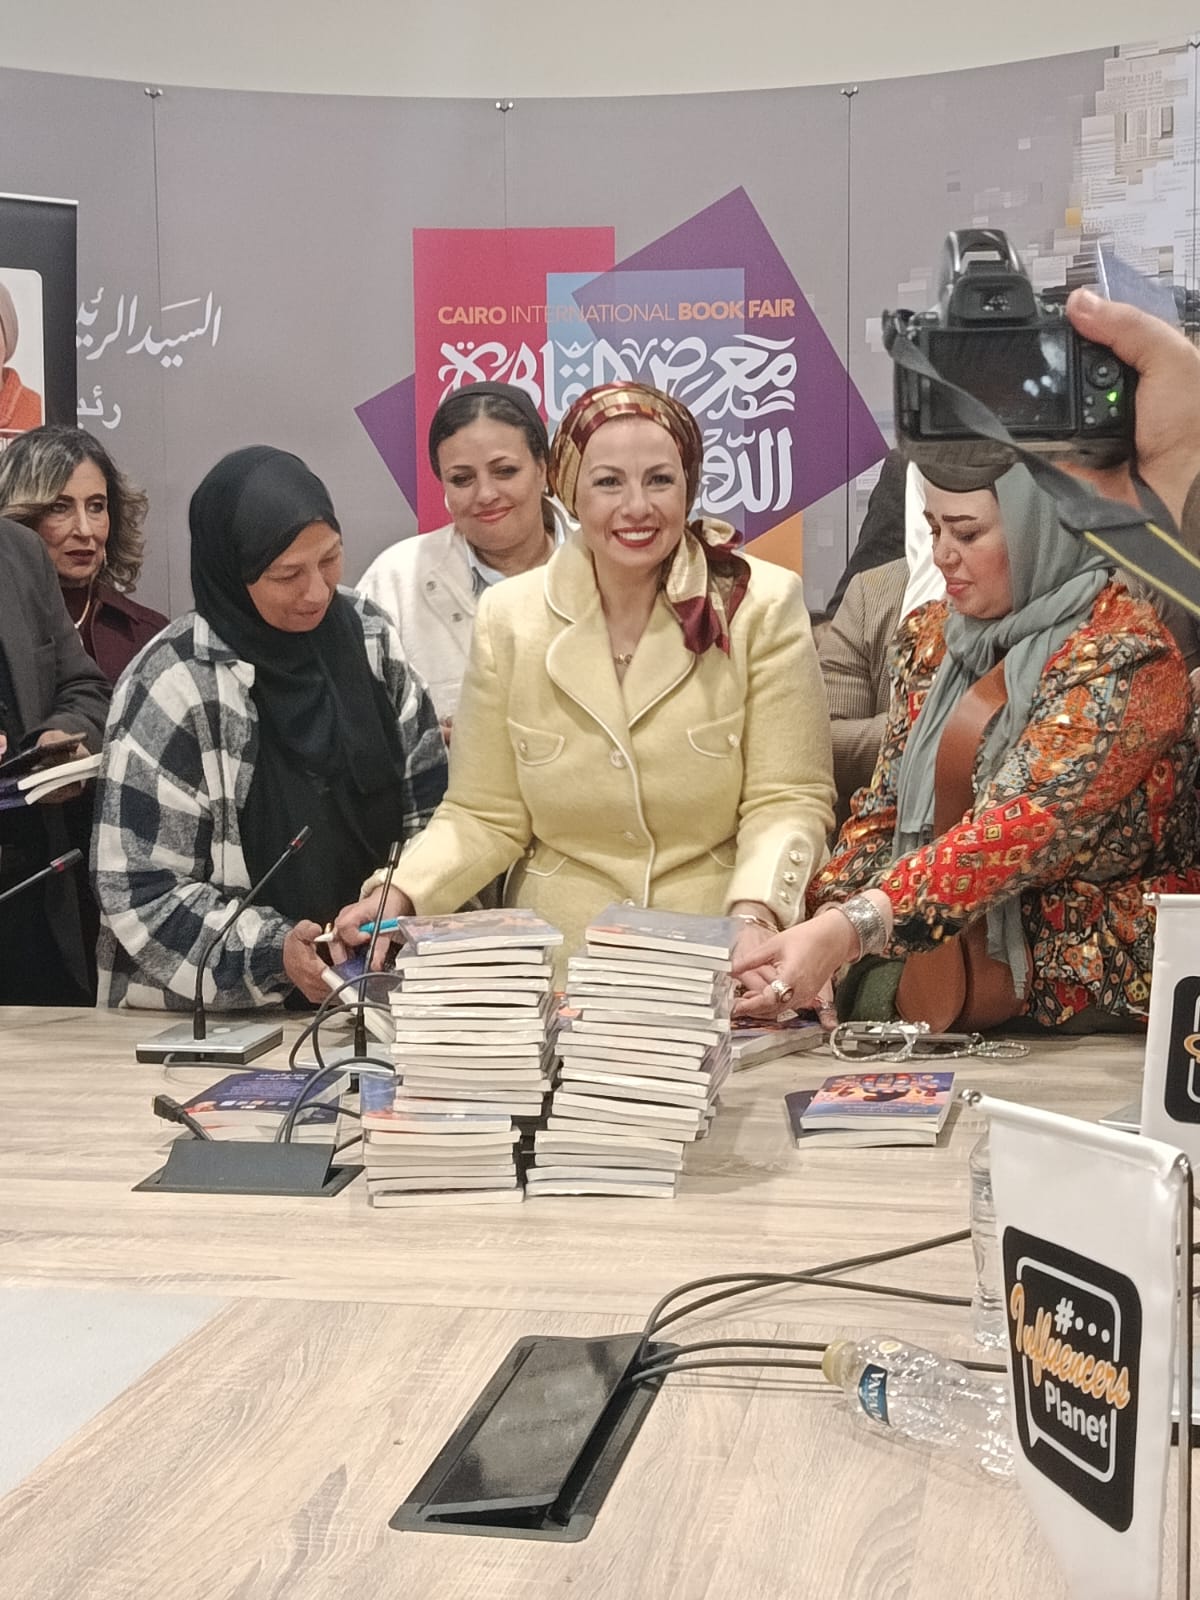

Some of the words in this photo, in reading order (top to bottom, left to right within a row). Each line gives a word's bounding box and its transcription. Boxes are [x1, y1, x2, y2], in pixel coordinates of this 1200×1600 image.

[76, 286, 138, 361] الرئي
[126, 290, 222, 368] السيد
[438, 305, 508, 325] CAIRO
[511, 302, 675, 324] INTERNATIONAL
[678, 300, 744, 321] BOOK
[748, 298, 796, 319] FAIR
[648, 334, 797, 420] معرض
[1010, 1282, 1131, 1411] Influencers
[1044, 1380, 1109, 1449] Planet
